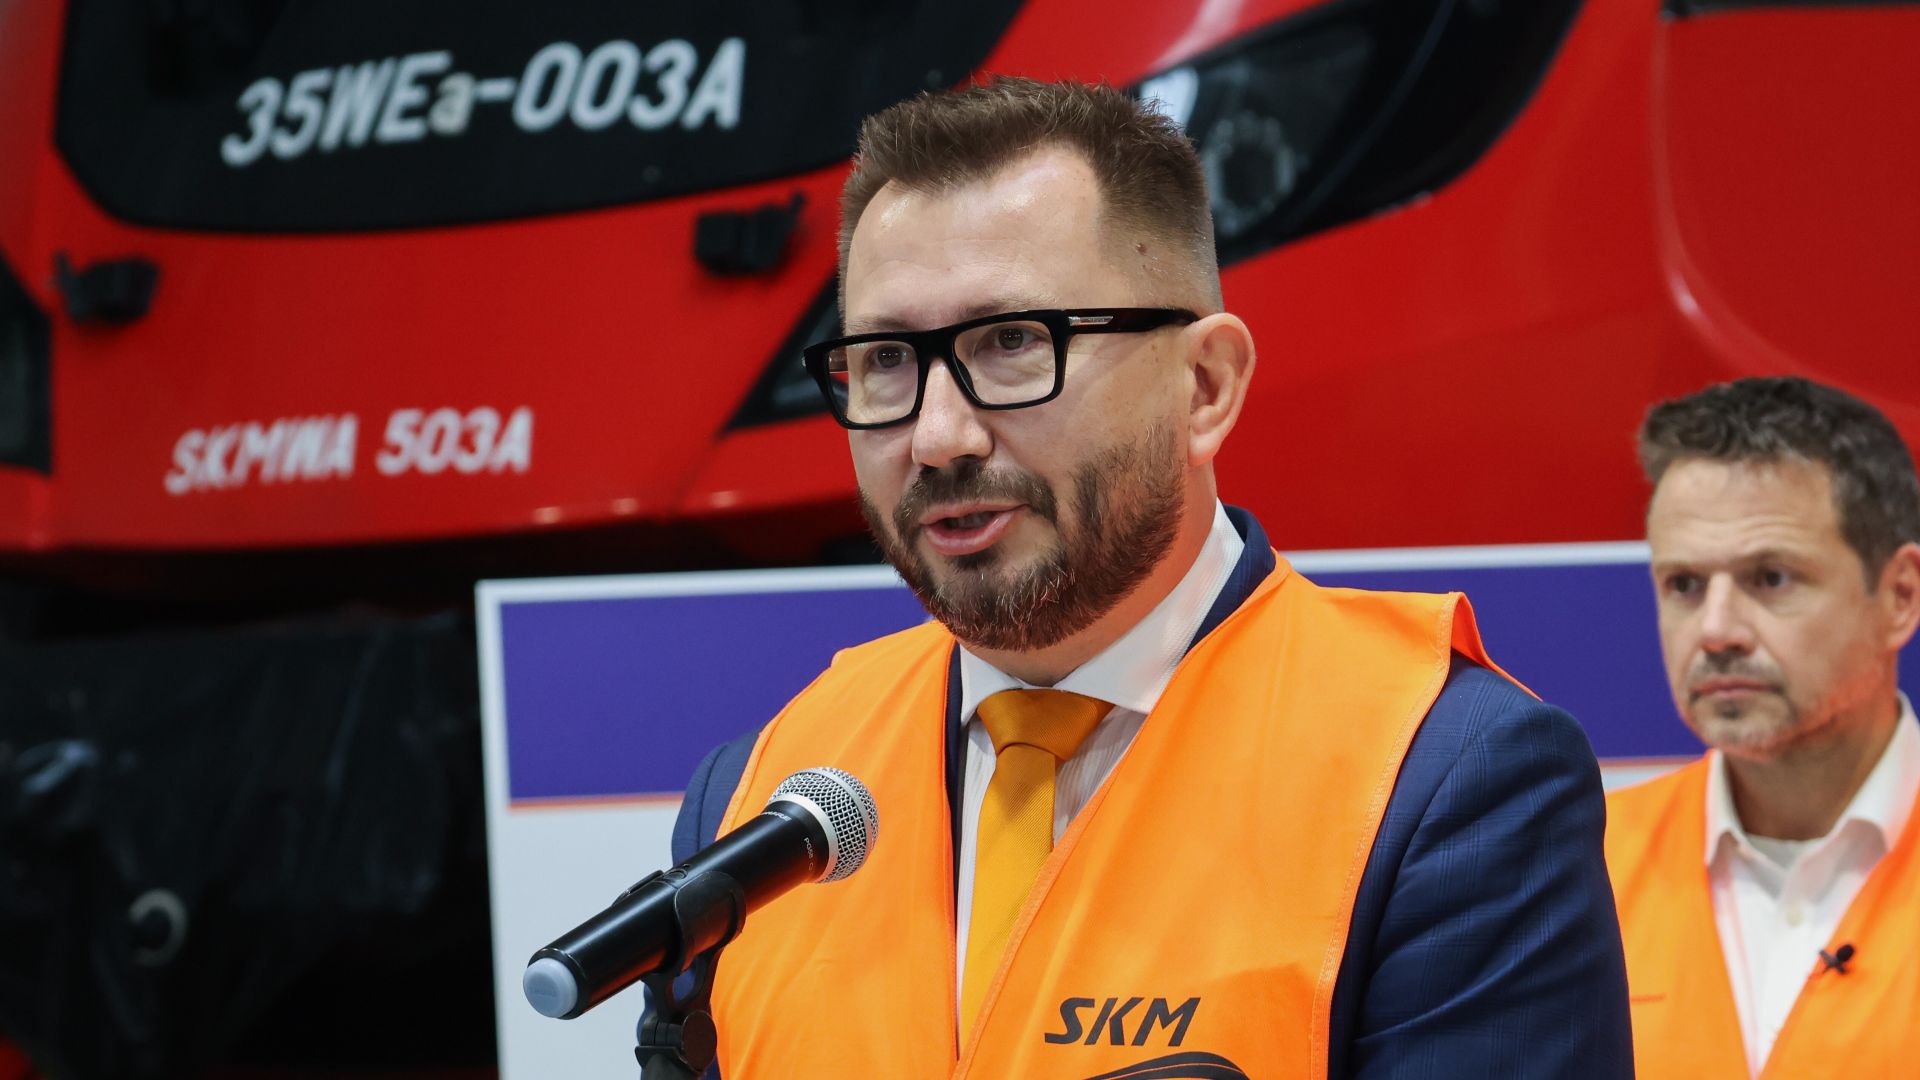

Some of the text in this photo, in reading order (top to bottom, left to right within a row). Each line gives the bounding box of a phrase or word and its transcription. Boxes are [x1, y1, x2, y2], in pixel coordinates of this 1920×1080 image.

[222, 38, 747, 166] 35WEa-003A
[164, 406, 534, 495] SKMWA 503A
[1044, 997, 1201, 1047] SKM
